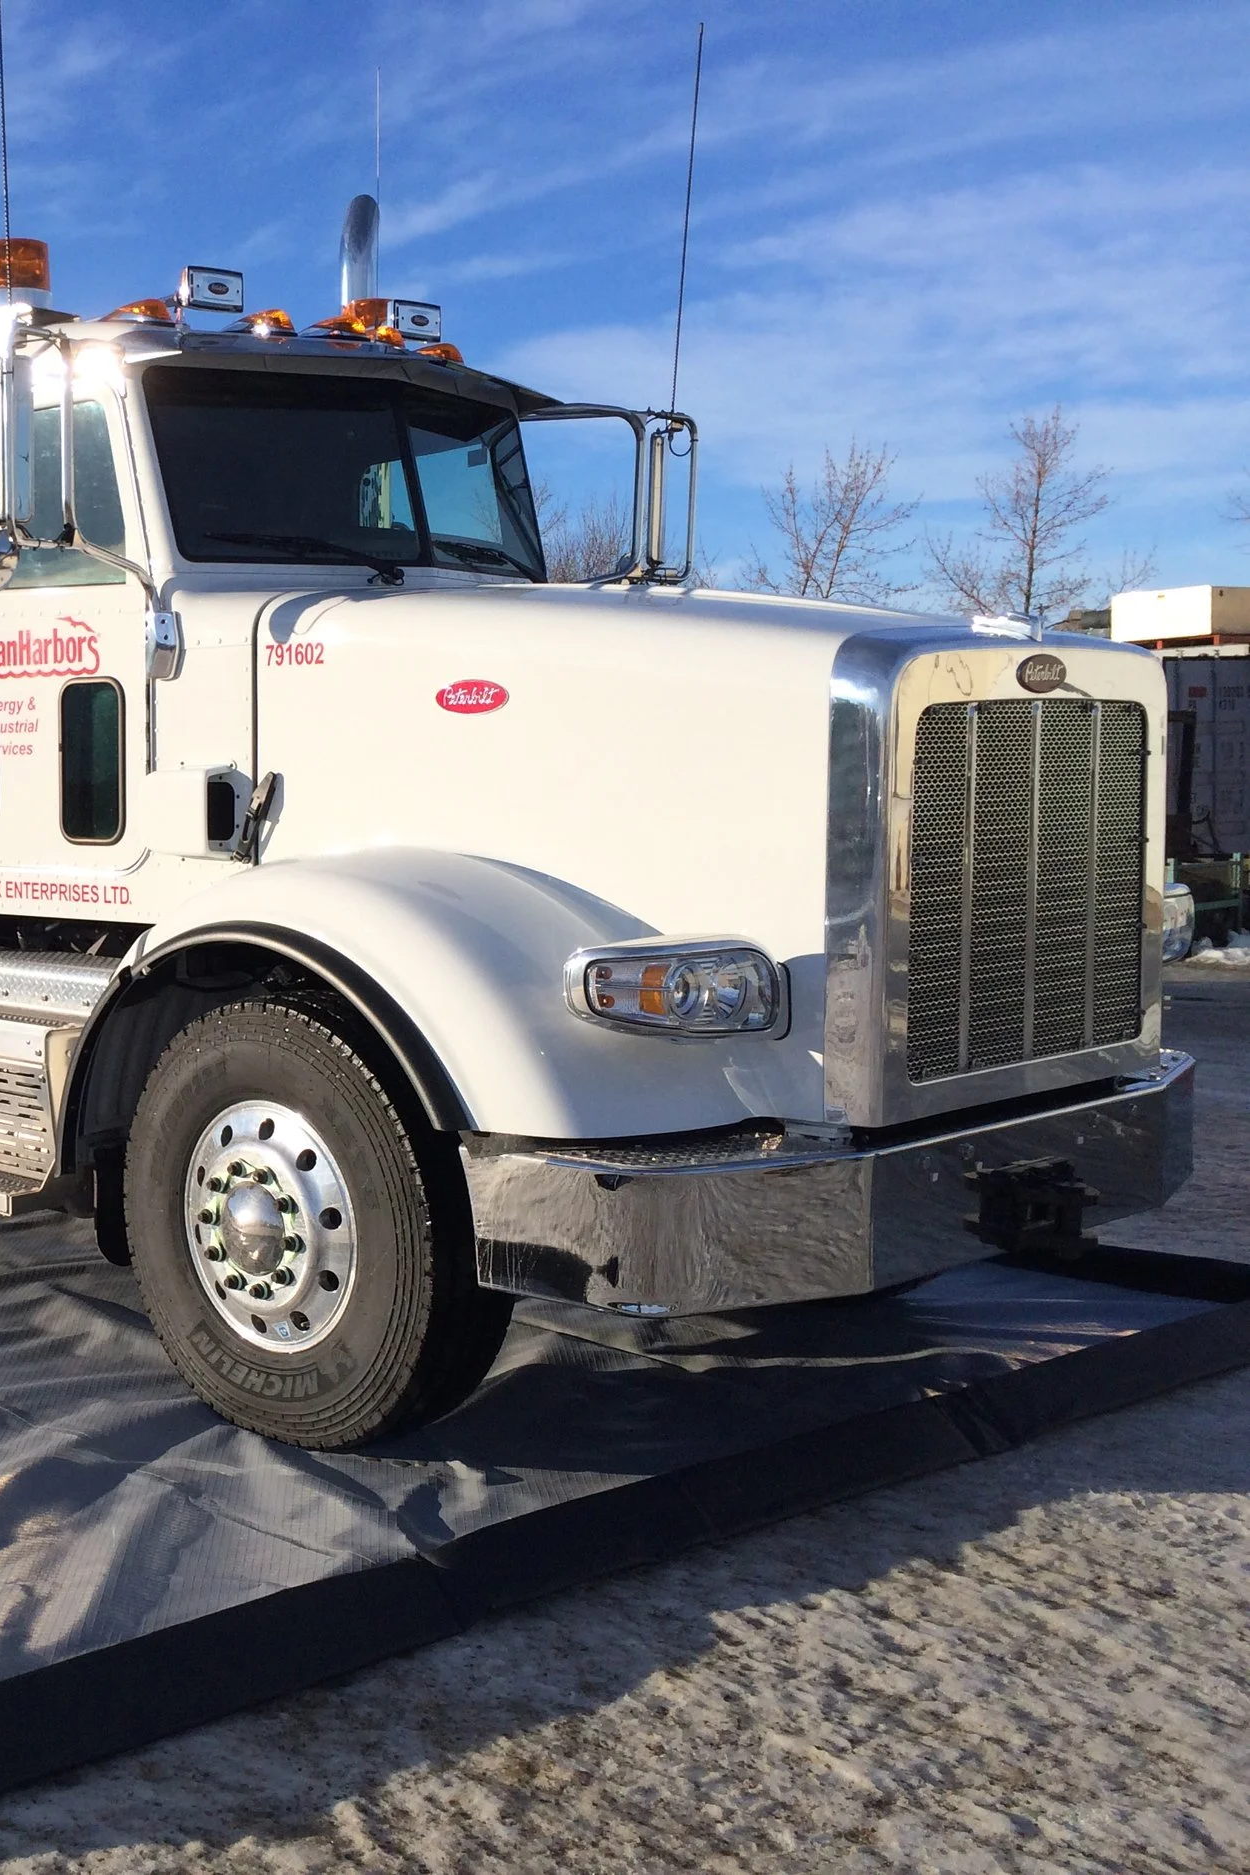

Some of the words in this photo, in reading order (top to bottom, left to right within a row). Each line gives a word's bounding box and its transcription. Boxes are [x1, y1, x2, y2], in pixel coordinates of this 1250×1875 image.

[265, 642, 325, 666] 791602
[1024, 661, 1064, 683] Peterbilt
[28, 696, 36, 711] &
[443, 686, 500, 707] Peterbilt
[6, 881, 100, 904] ENTERPRISES
[104, 886, 132, 905] LTD.
[193, 1330, 319, 1398] MICHELIN
